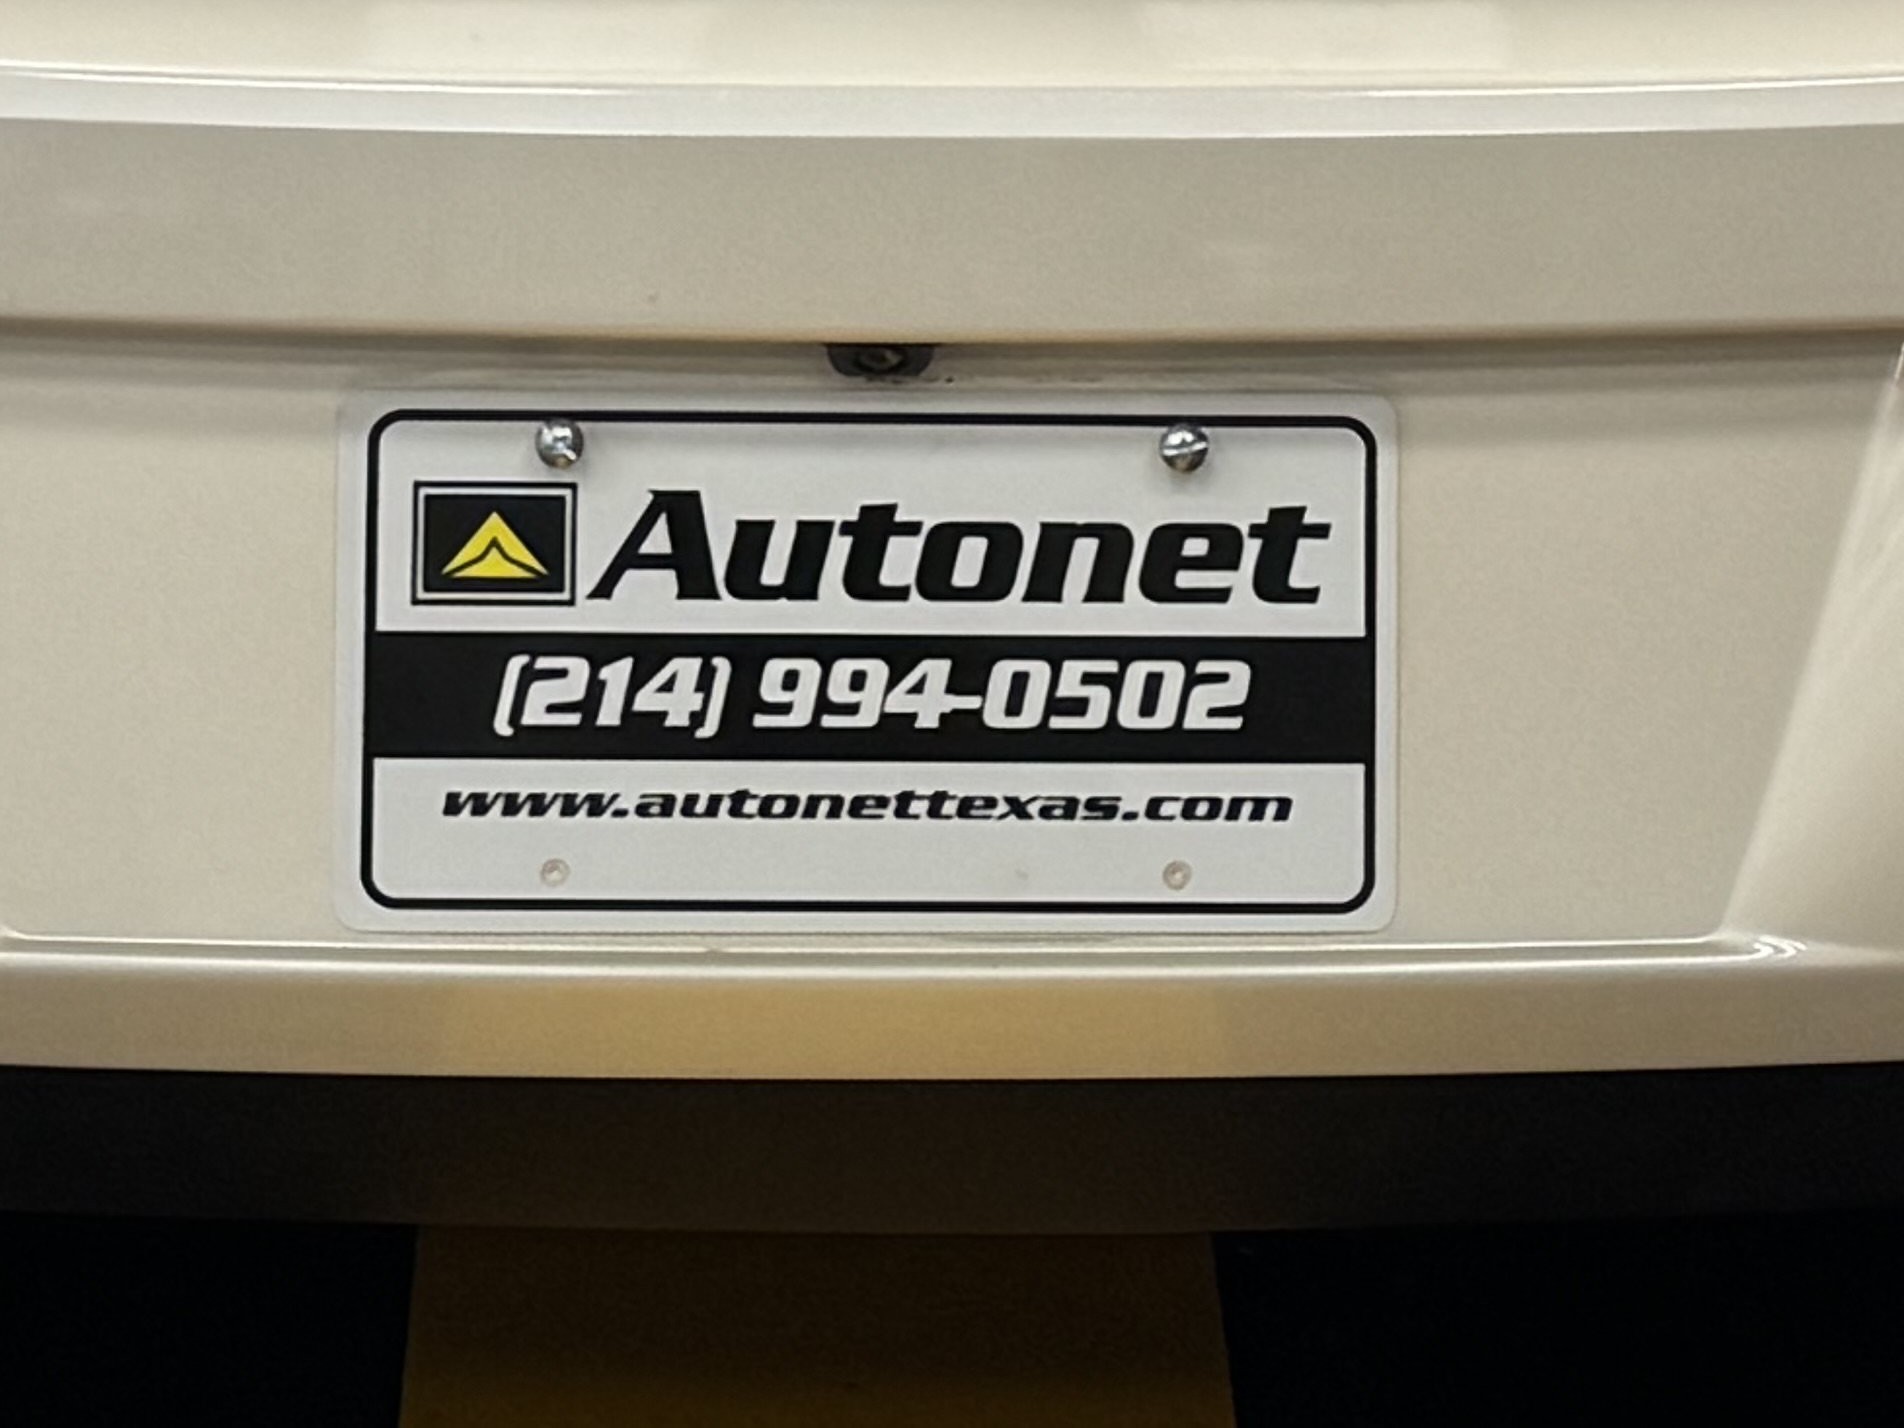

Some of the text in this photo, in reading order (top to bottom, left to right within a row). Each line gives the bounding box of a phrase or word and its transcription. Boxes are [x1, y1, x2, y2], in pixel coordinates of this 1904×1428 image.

[587, 489, 1331, 604] Autonet
[494, 654, 1253, 739] (214) 994-0502
[441, 783, 1294, 823] www.autonettexas.com
